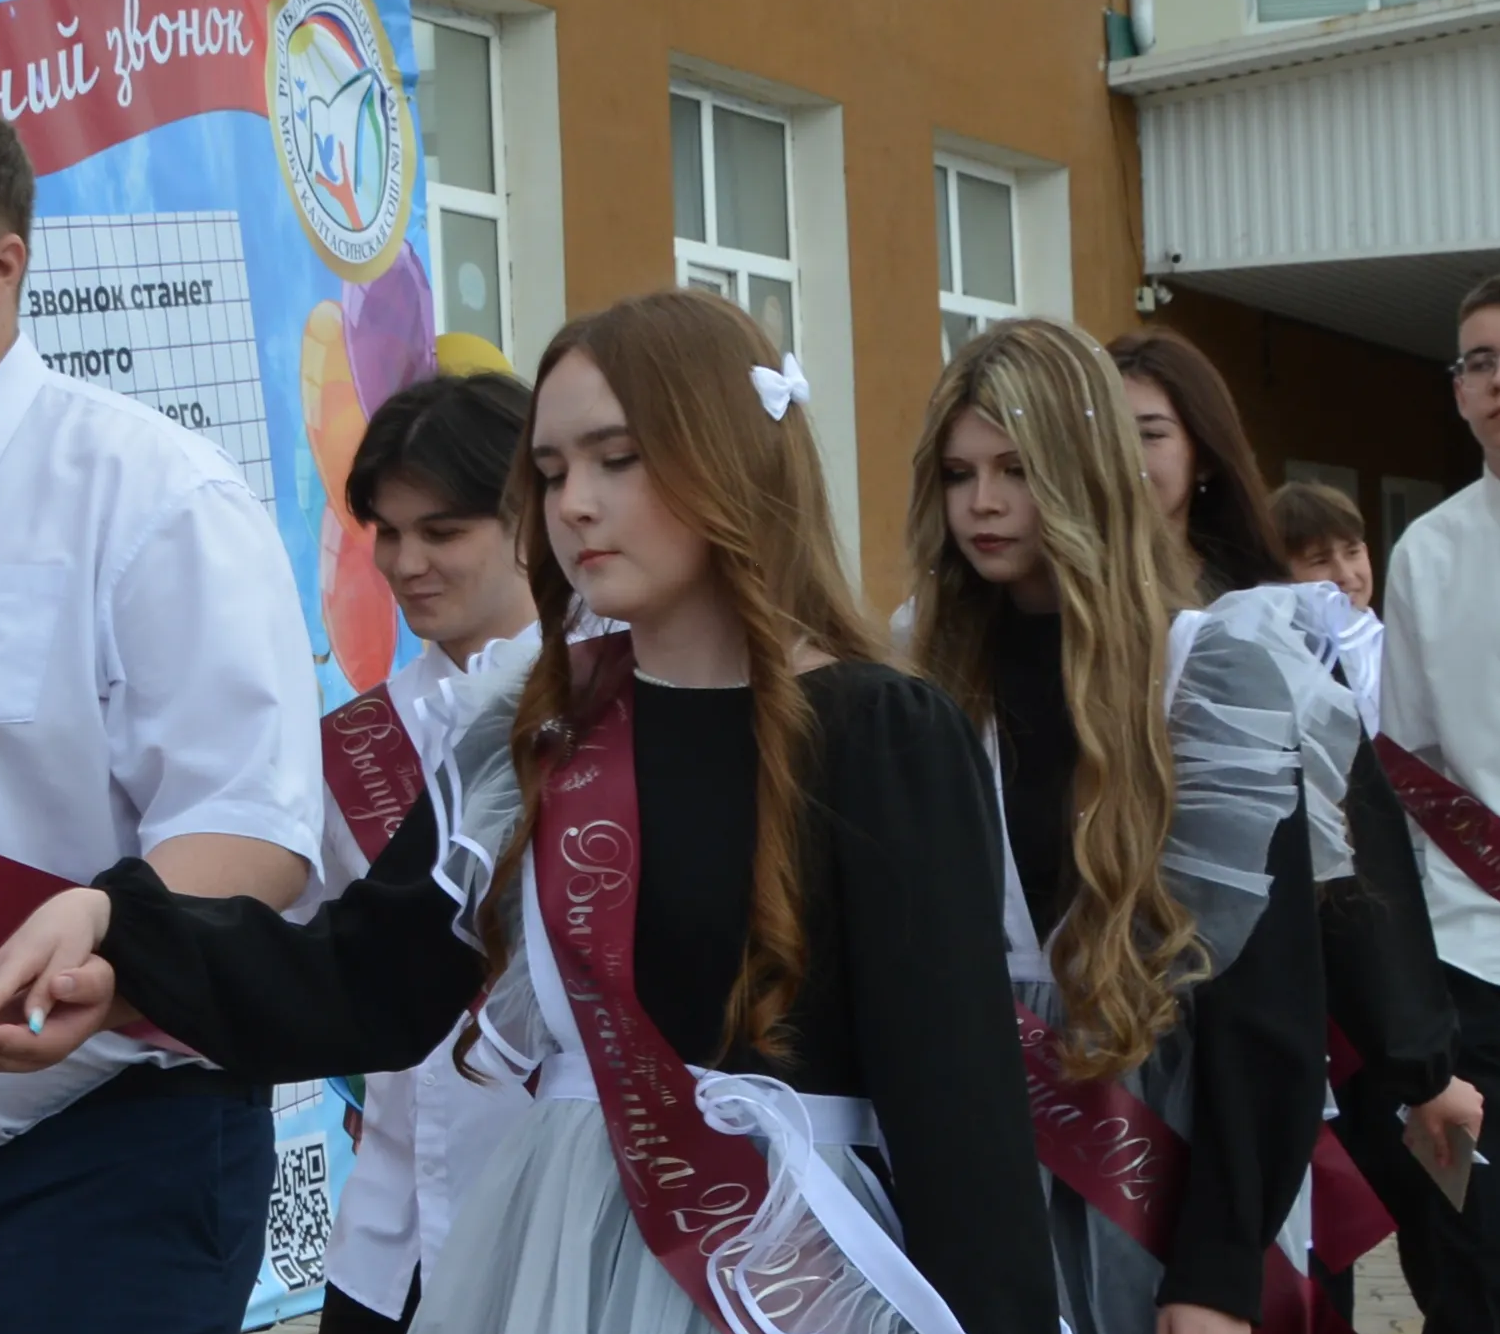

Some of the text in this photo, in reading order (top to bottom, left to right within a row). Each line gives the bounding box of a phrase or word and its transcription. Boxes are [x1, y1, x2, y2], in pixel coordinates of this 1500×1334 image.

[27, 278, 213, 317] звонок станет
[560, 819, 832, 1320] Выпускница 2026
